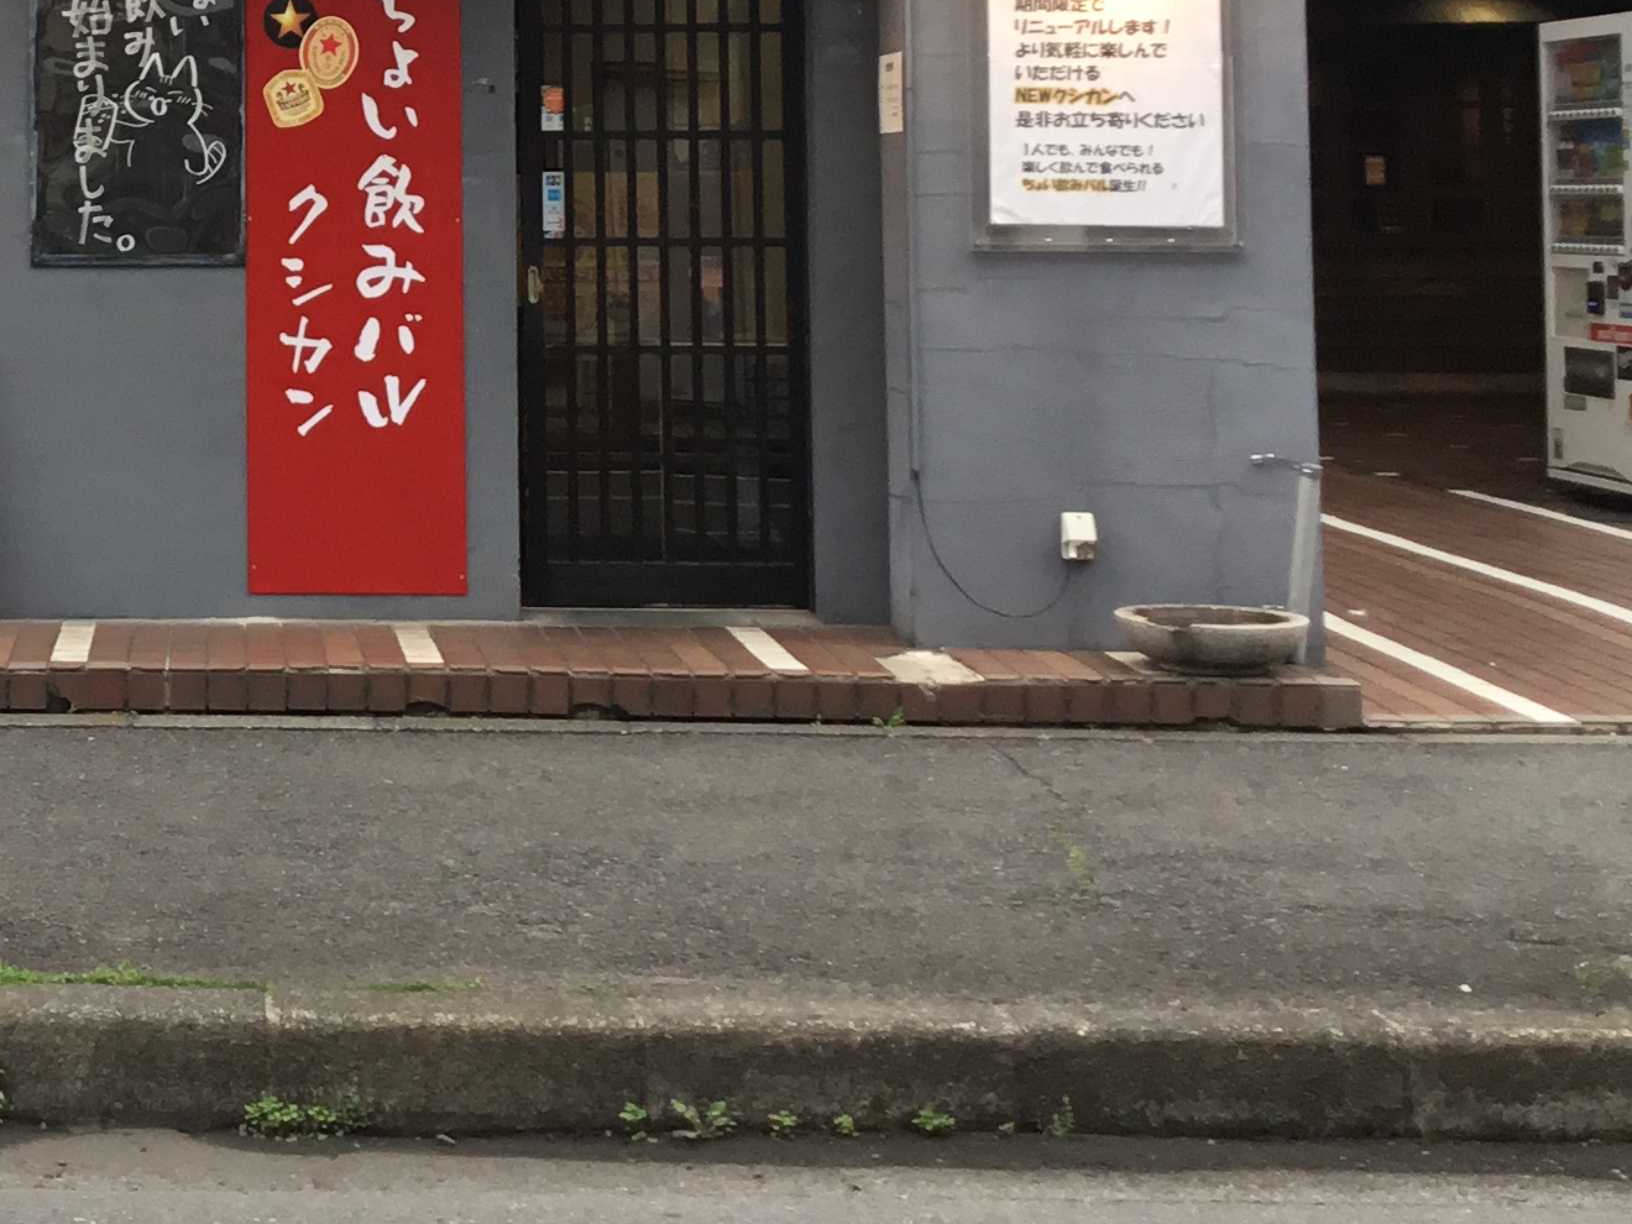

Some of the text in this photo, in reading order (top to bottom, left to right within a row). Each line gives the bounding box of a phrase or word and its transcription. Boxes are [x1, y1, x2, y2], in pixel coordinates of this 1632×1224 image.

[1014, 65, 1101, 82] いただける
[278, 183, 335, 437] クシカン
